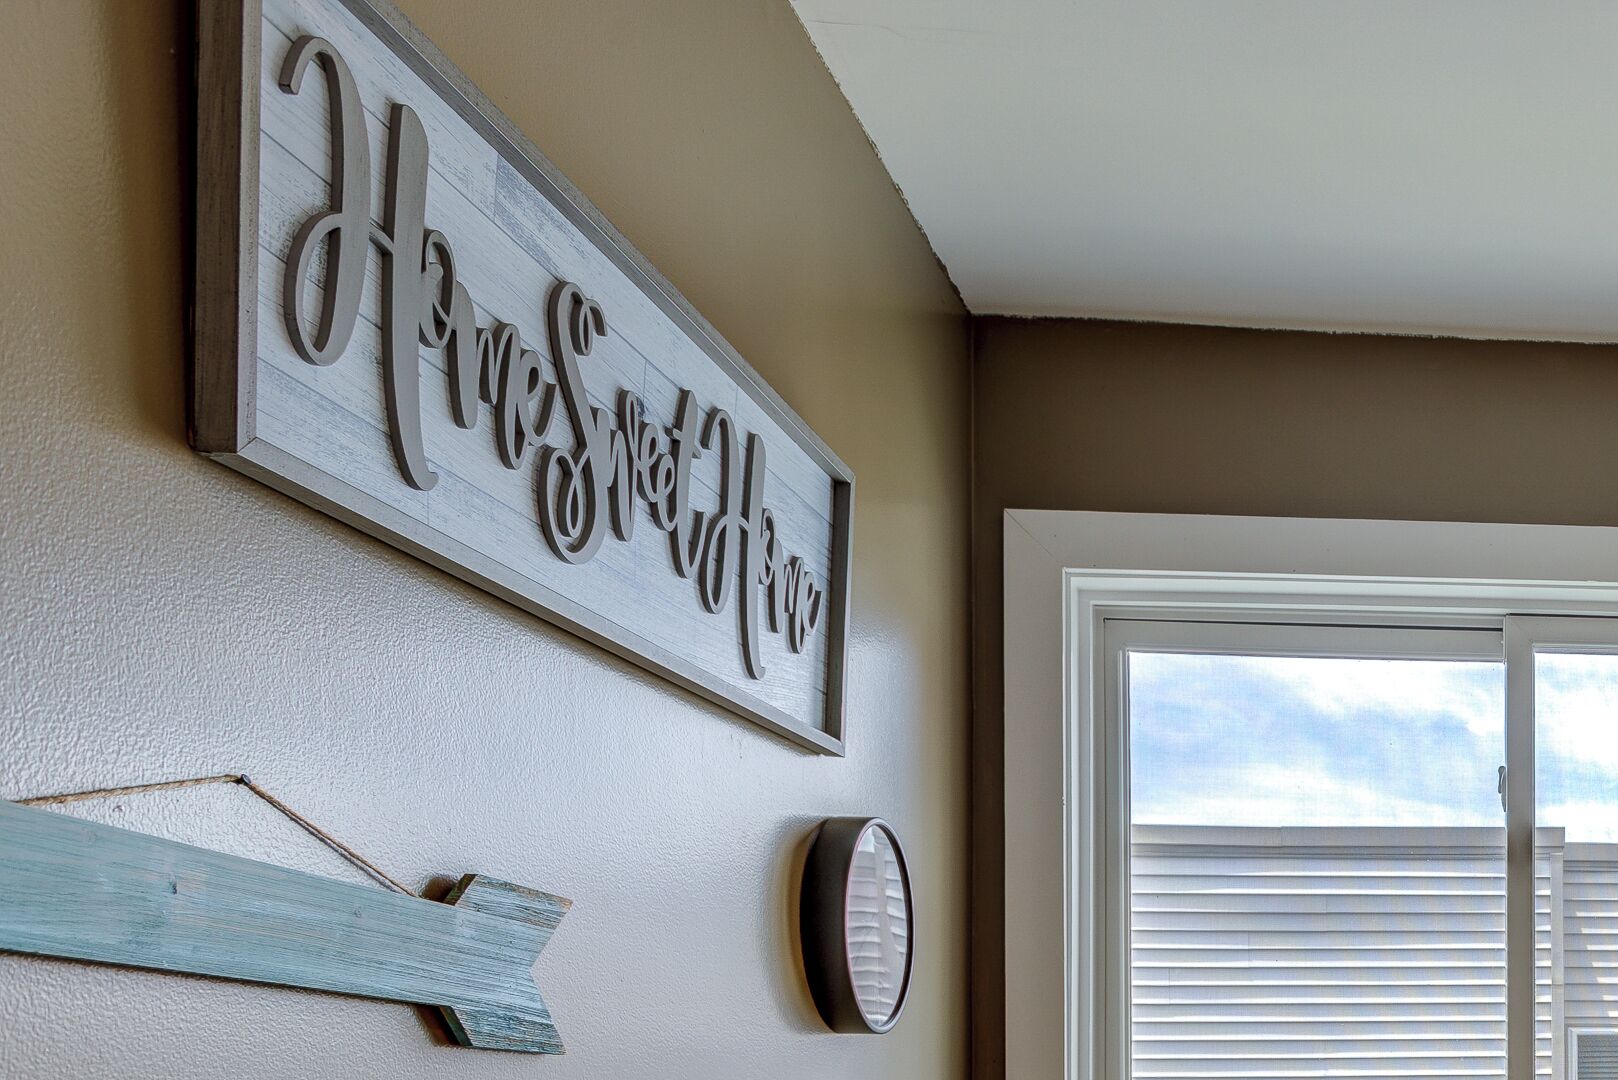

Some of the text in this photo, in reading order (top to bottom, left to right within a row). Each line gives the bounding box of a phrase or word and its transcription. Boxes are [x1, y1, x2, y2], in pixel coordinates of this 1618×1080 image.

[279, 35, 823, 680] Home Sweet Home
